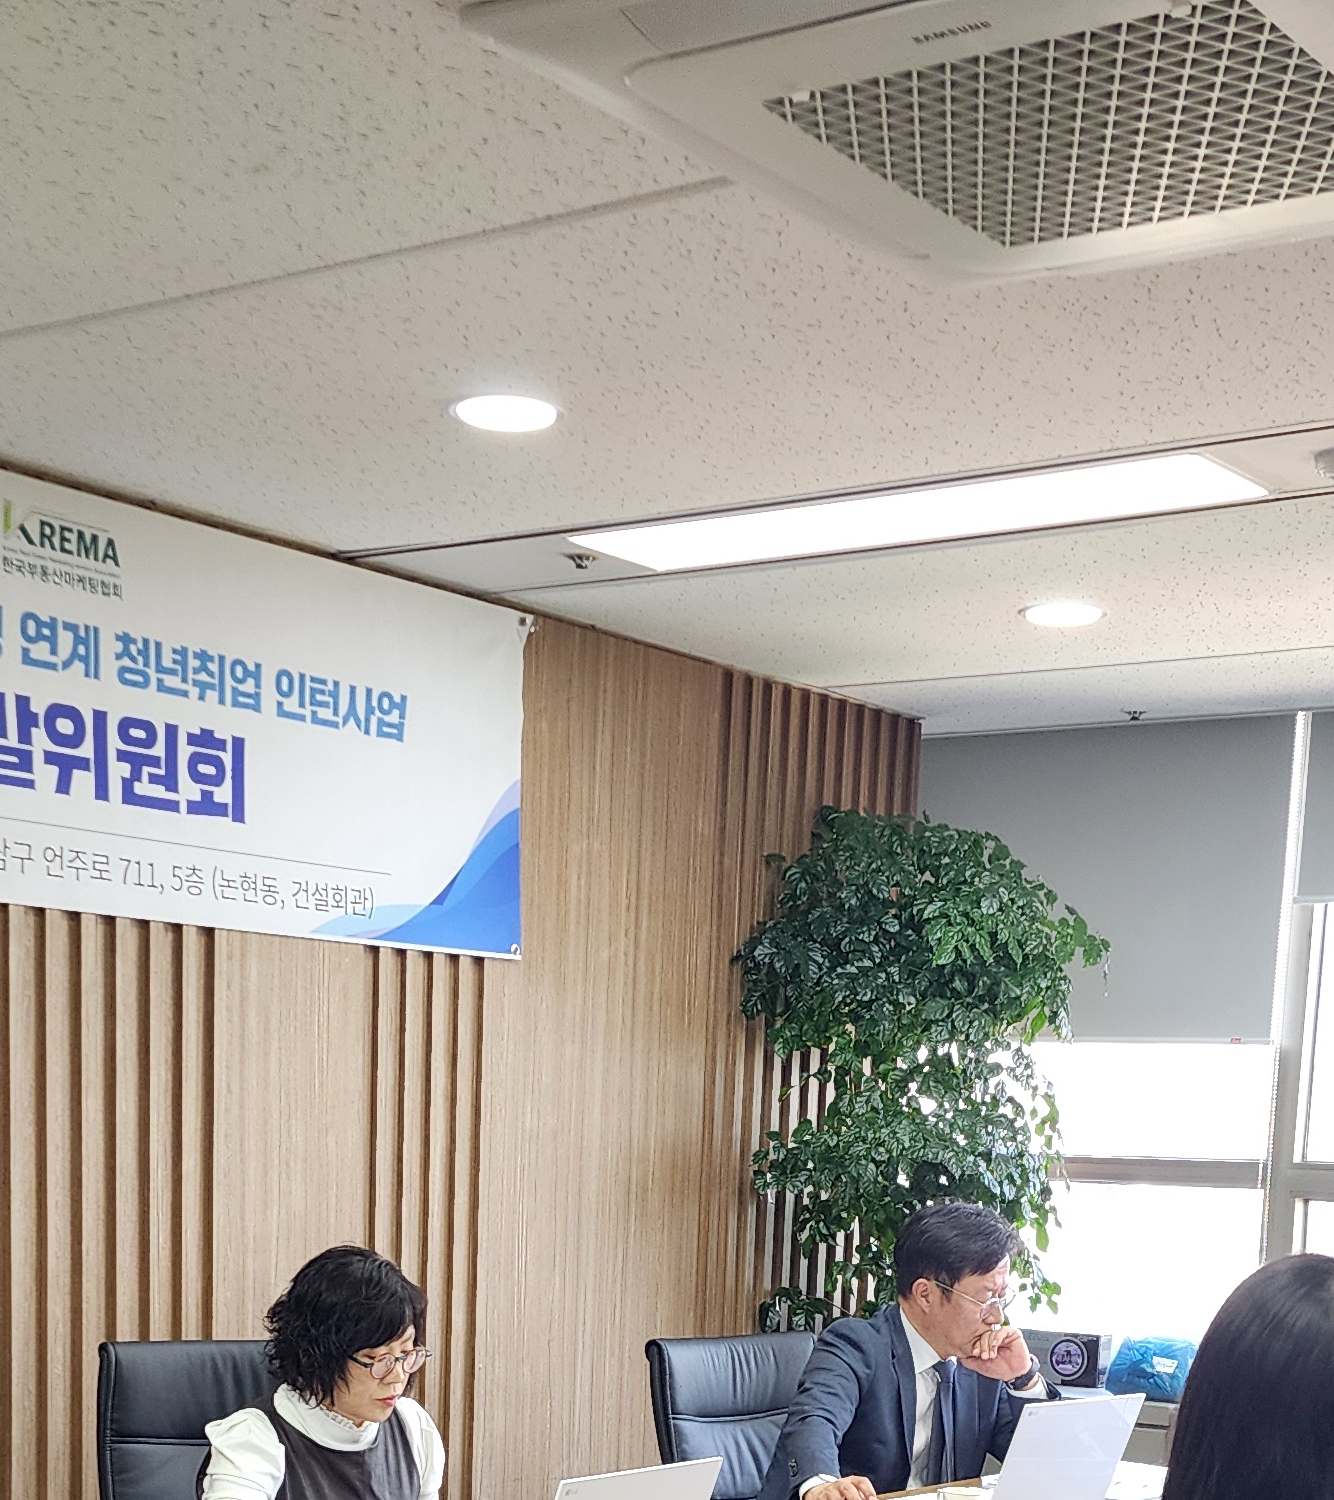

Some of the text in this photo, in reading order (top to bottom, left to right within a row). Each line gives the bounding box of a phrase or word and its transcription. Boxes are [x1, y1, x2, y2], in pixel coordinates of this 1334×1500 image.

[20, 610, 101, 681] 연계
[114, 630, 263, 714] 청년취업
[275, 668, 408, 743] 인턴사업
[43, 845, 113, 882] 언주로
[171, 864, 206, 896] 5층
[211, 865, 286, 910] (논현동,
[291, 880, 377, 920] 건설회관)
